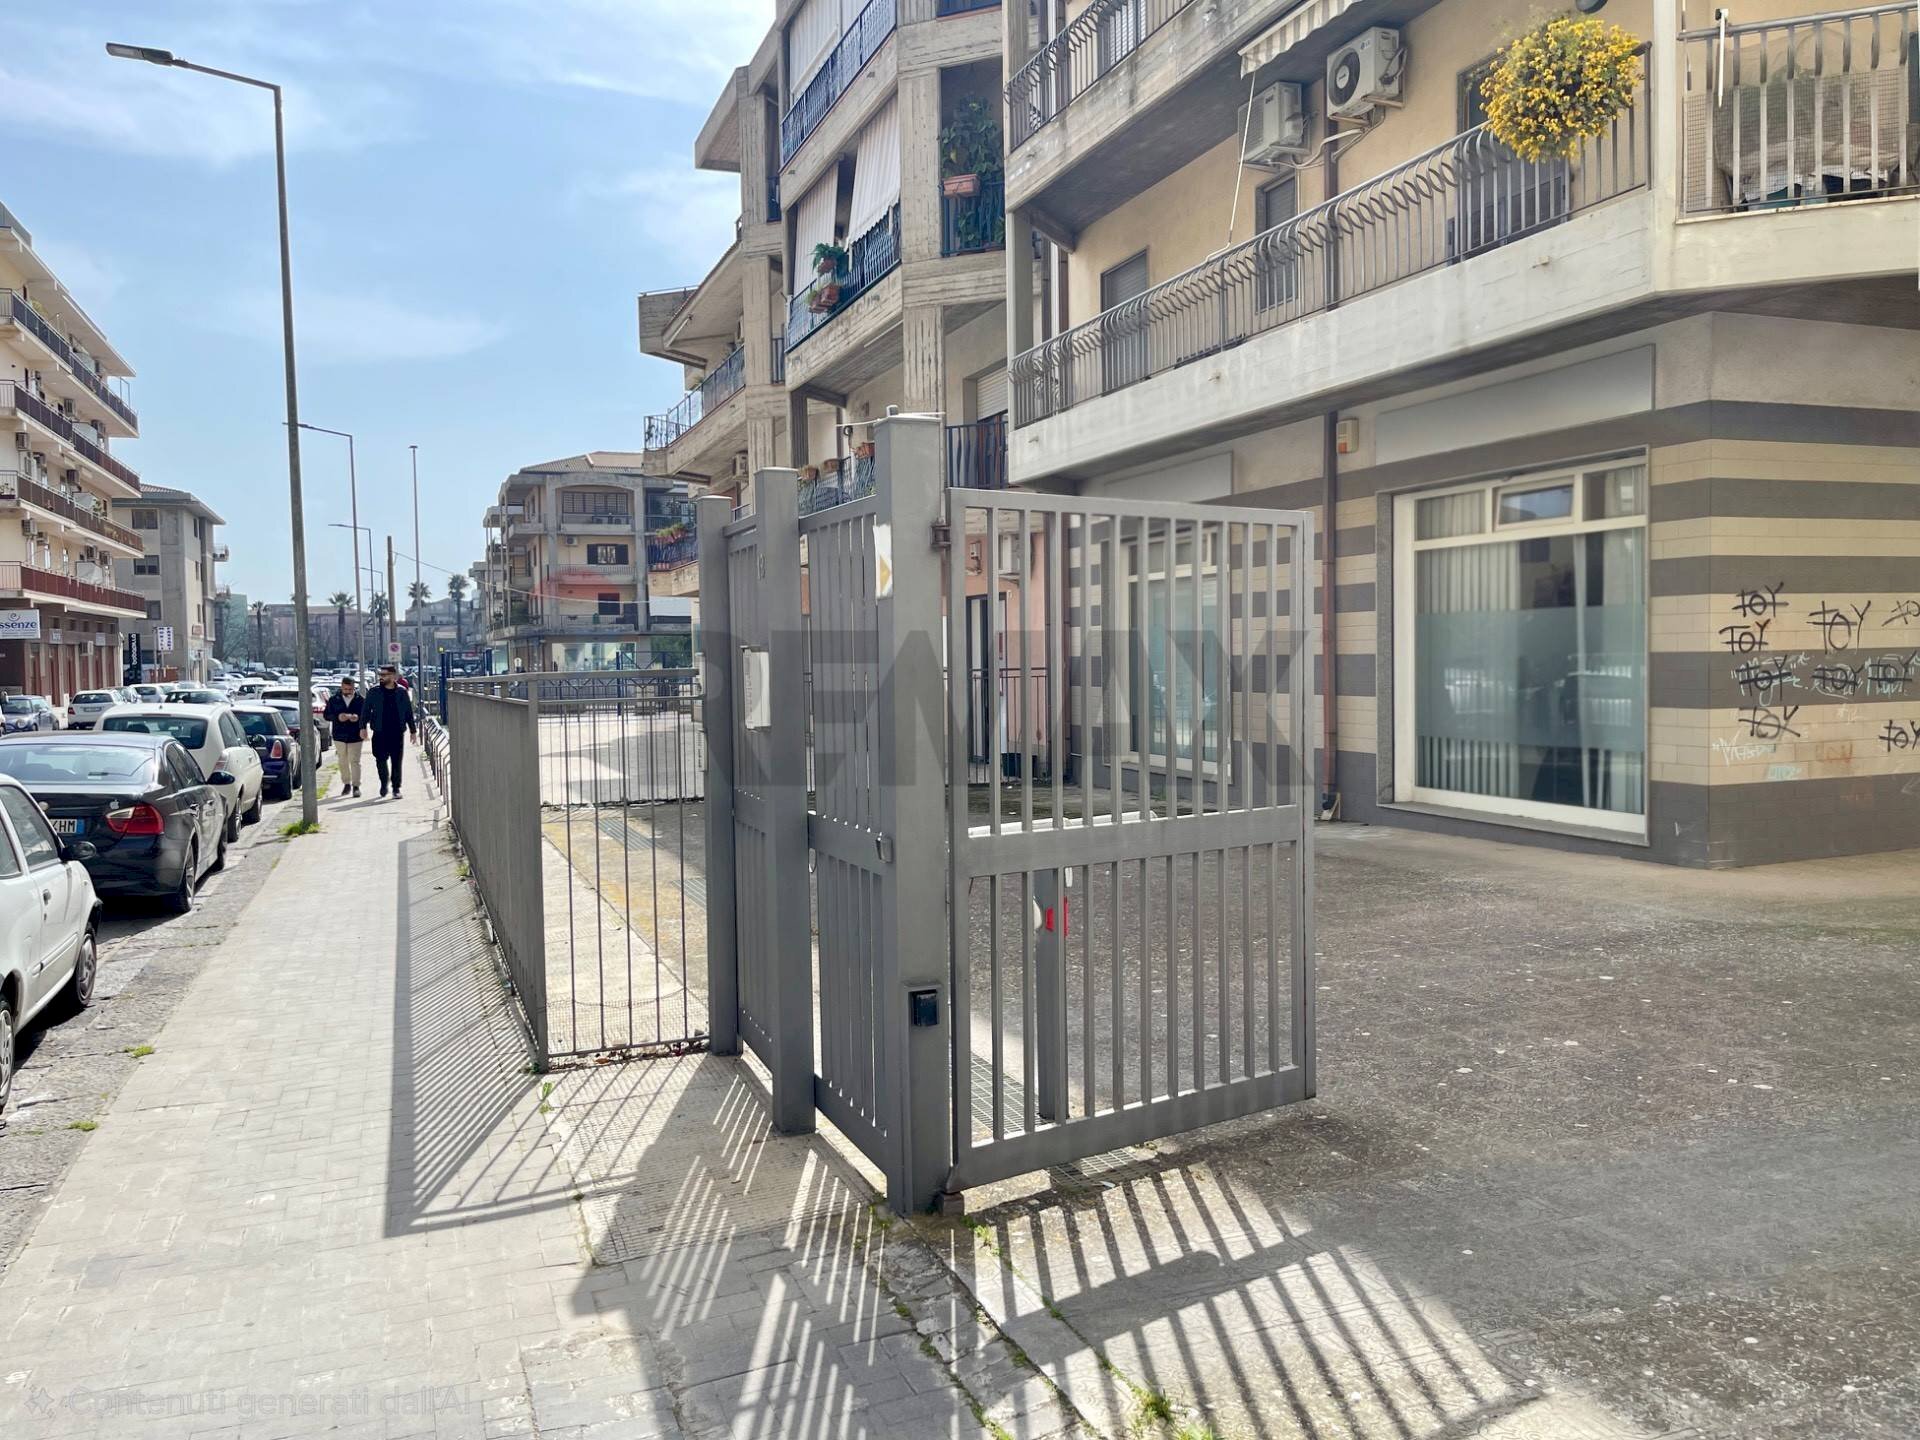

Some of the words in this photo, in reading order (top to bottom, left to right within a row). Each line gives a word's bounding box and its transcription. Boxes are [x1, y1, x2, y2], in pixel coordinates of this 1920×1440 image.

[1733, 581, 1788, 618] TOY
[1719, 618, 1771, 655] TOY
[1807, 600, 1871, 655] TOY
